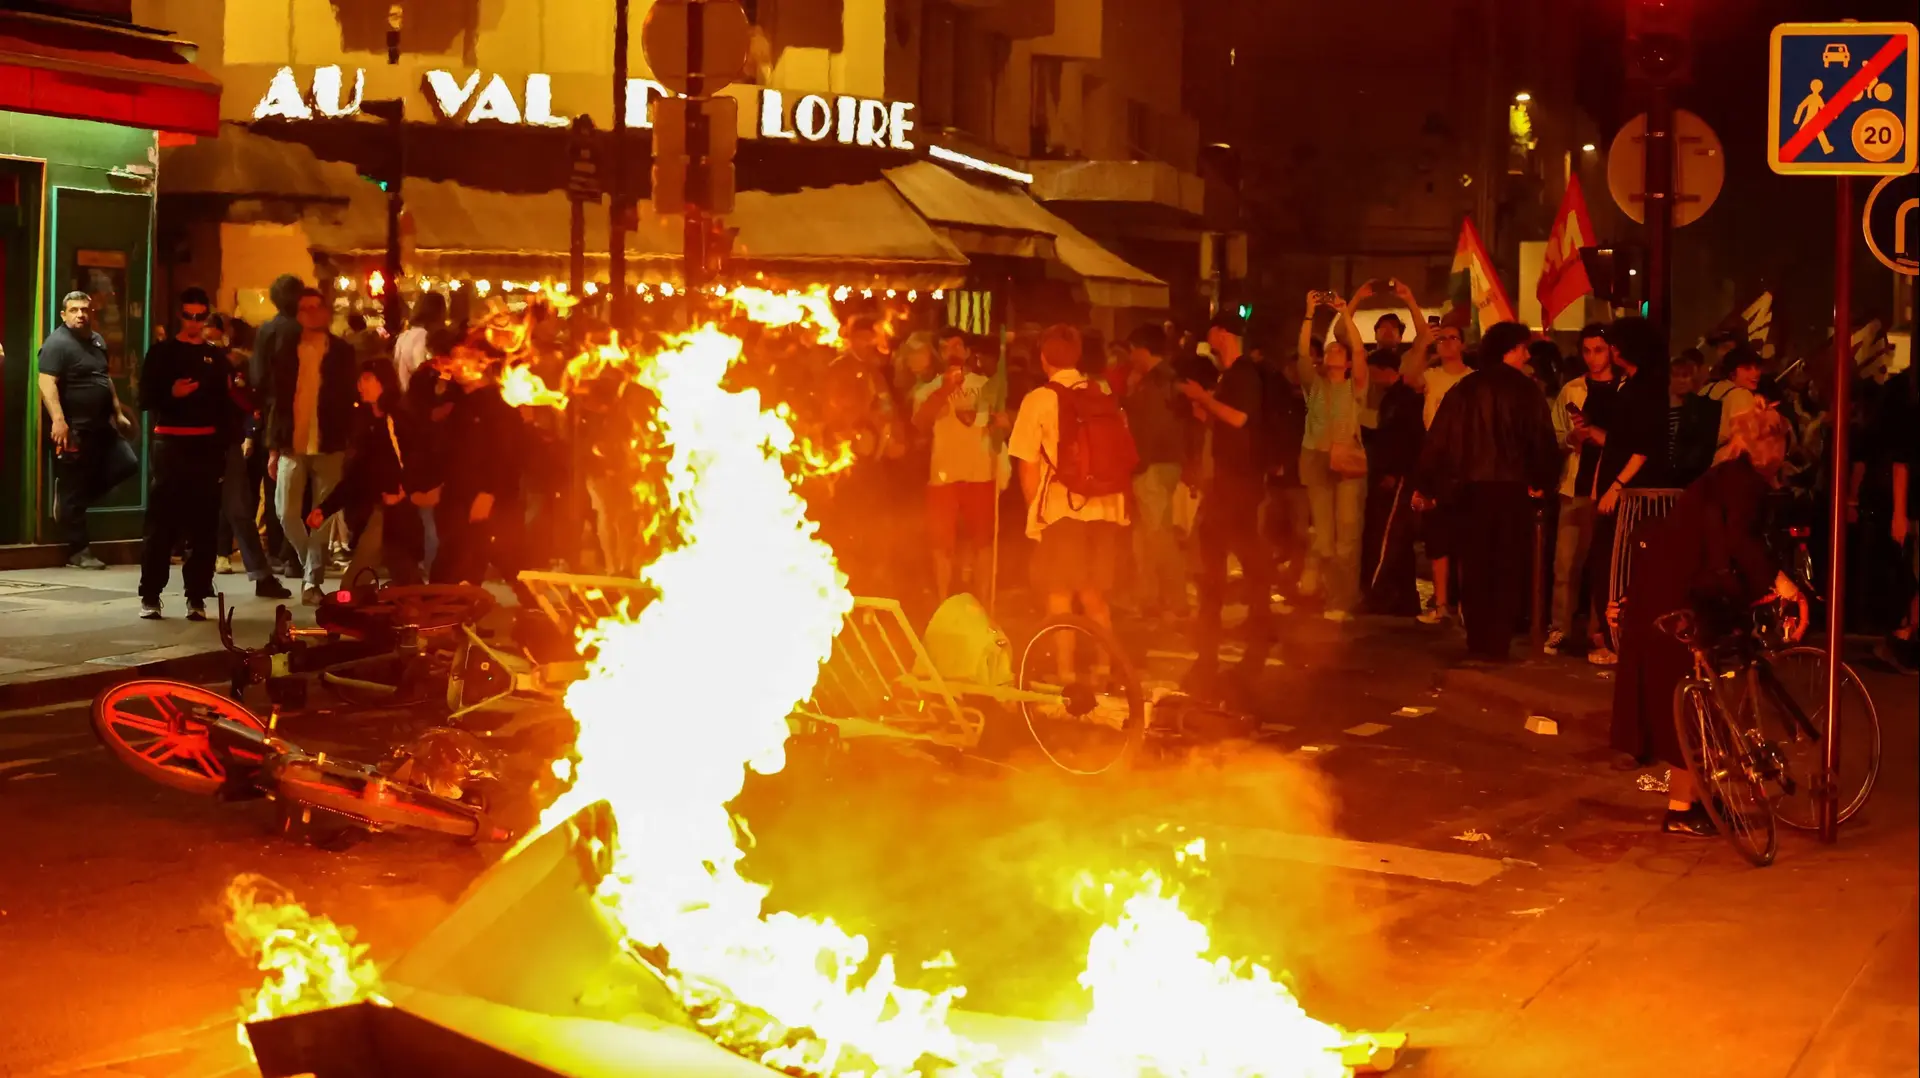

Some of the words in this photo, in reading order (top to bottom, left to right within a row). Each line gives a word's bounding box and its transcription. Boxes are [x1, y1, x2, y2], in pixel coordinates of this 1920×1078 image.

[252, 63, 366, 123] AU
[425, 69, 571, 128] VAL
[624, 78, 688, 129] D
[761, 88, 916, 150] LOIRE
[1863, 126, 1892, 145] 20
